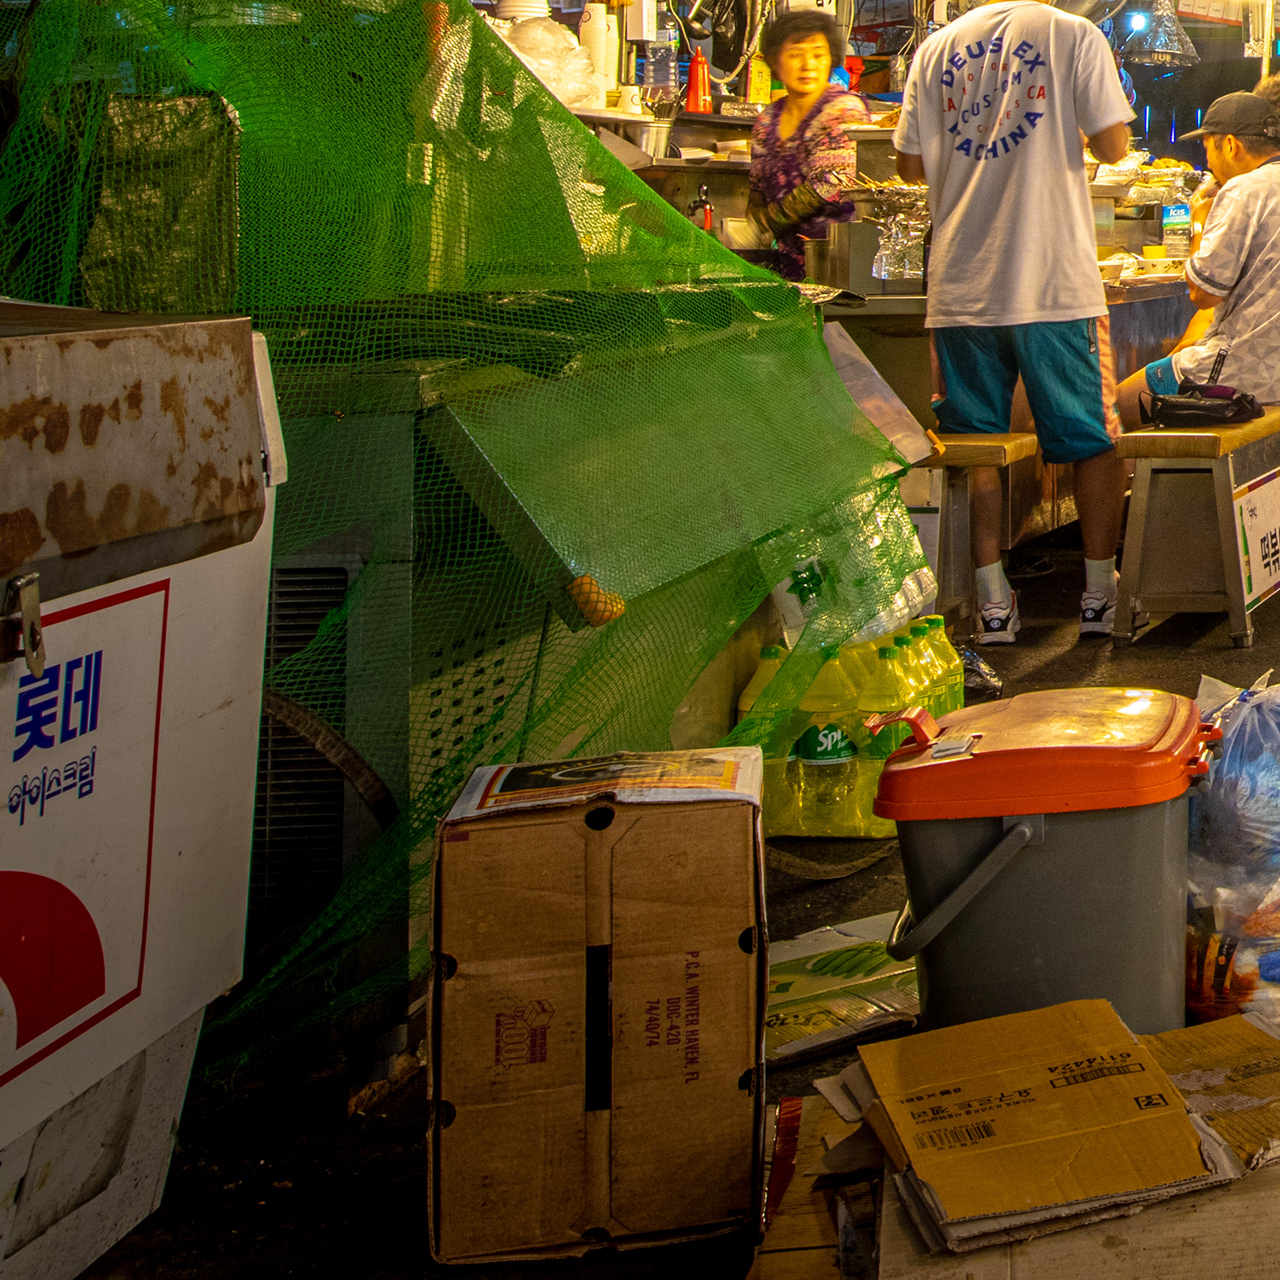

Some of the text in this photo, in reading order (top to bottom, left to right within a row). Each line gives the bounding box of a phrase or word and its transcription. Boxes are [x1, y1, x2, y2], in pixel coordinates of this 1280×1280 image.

[941, 36, 1046, 89] DEUS EX
[1027, 85, 1046, 100] CA
[12, 649, 103, 763] 롯데
[8, 745, 97, 826] 아이스크림
[644, 998, 661, 1047] 74/40/74
[683, 951, 700, 1085] P.C.A. WINTER HAVEN, FL
[1047, 1052, 1131, 1073] 6114424
[953, 1088, 1032, 1112] 요구르트
